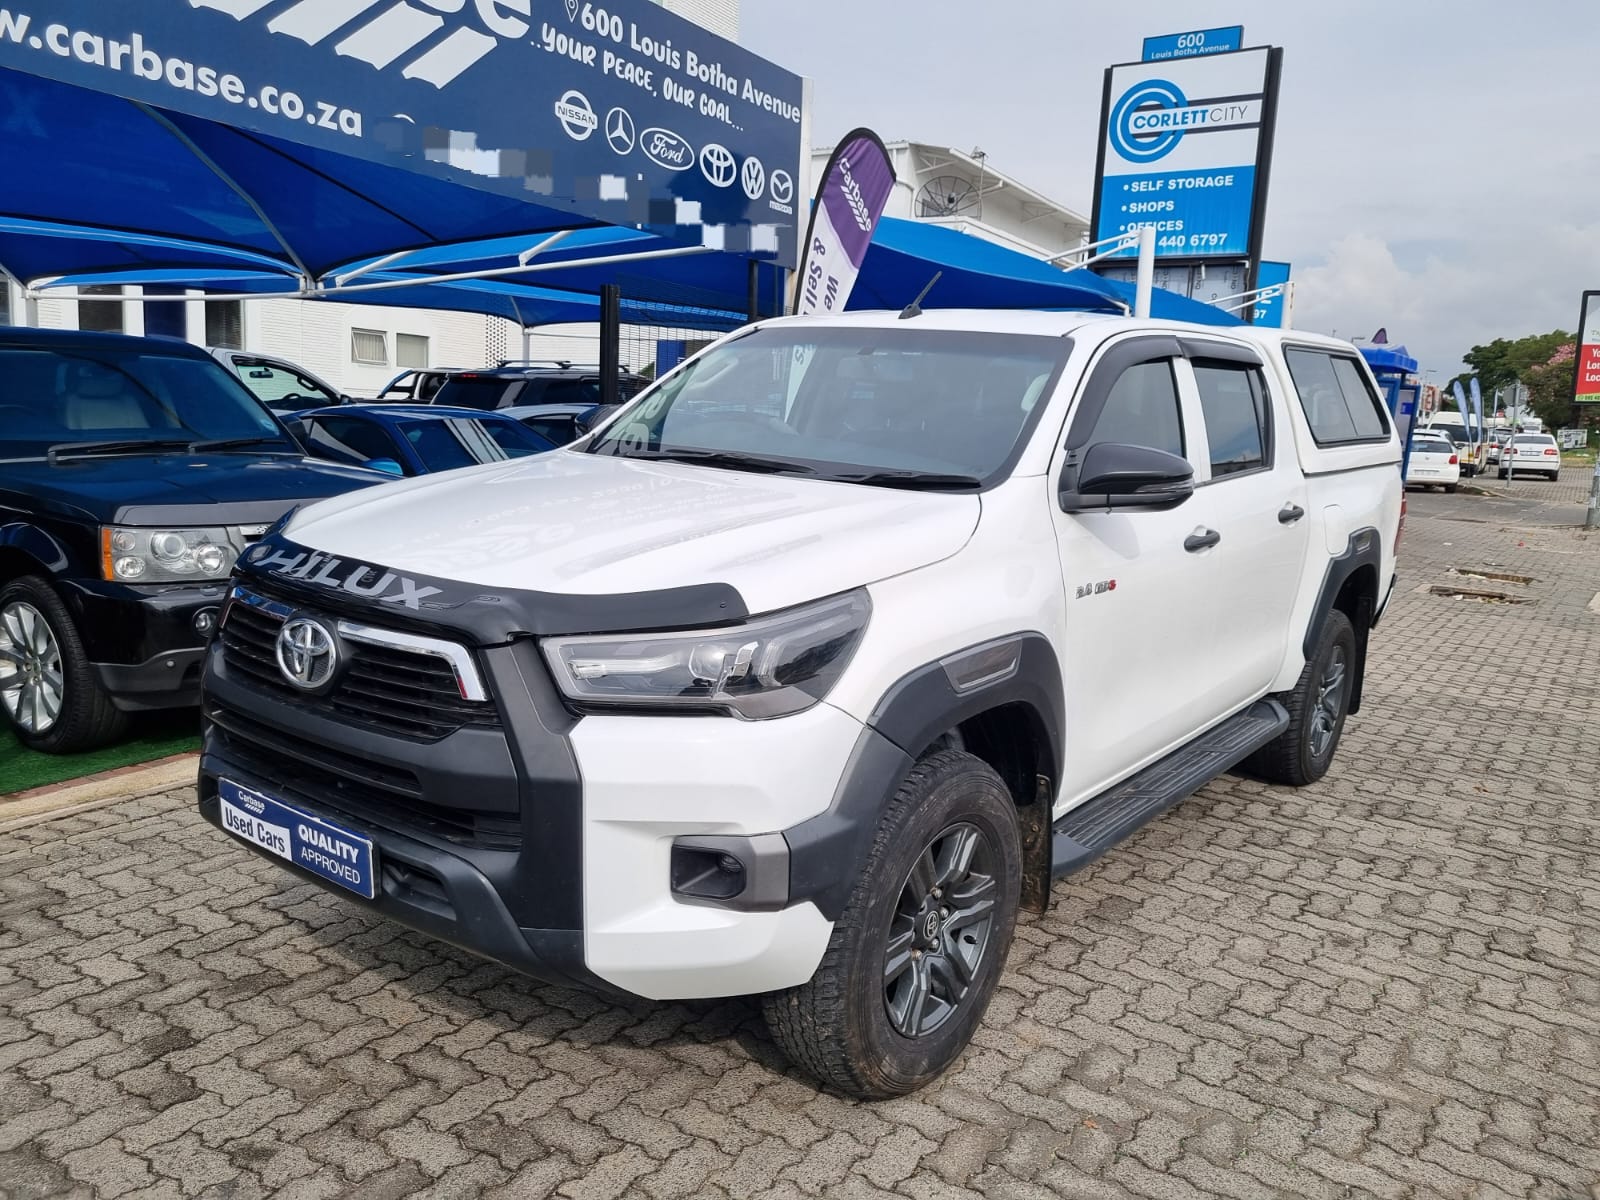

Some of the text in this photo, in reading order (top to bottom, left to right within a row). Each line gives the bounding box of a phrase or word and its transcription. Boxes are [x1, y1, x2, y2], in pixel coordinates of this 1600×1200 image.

[1151, 44, 1230, 60] Louis Botha Avenue
[1177, 33, 1205, 48] 600
[581, 3, 624, 43] 600
[631, 24, 681, 70] Louis
[686, 50, 738, 96] Botha
[742, 79, 801, 123] Avenue
[663, 77, 695, 108] OUR
[557, 104, 596, 127] NISSAN
[650, 133, 685, 164] Ford
[838, 158, 872, 232] Carbase
[1131, 175, 1234, 192] SELF STORAGE
[1129, 200, 1174, 214] SHOPS
[1158, 233, 1228, 247] 440 6797
[804, 237, 826, 309] & Sell
[824, 275, 839, 311] We
[254, 550, 443, 610] HILUX
[238, 790, 265, 810] Carbase
[225, 806, 285, 853] Used Cars
[298, 824, 359, 864] QUALITY
[301, 847, 361, 884] APPROVED
